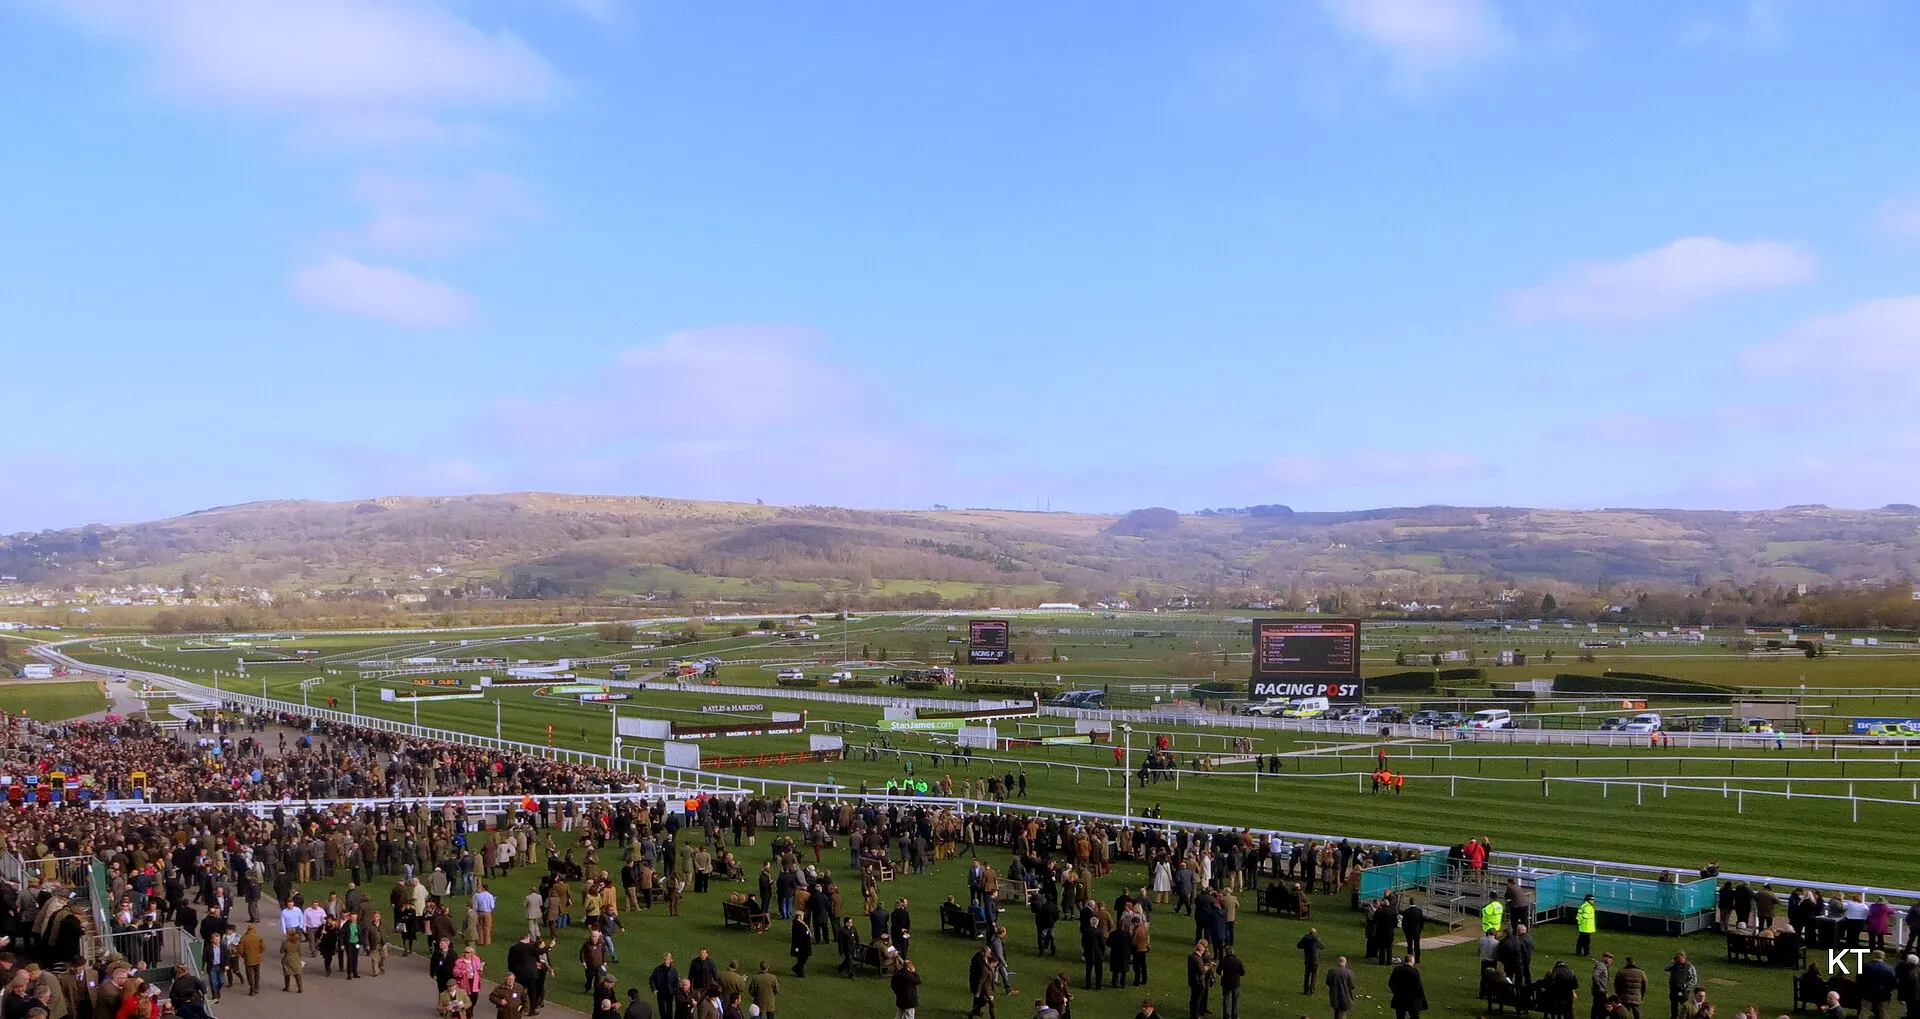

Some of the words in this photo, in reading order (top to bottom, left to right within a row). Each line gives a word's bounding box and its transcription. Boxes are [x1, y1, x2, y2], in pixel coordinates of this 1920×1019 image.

[1255, 683, 1314, 696] RACING
[1316, 684, 1358, 697] POST
[702, 705, 725, 713] BAYLIS
[731, 704, 764, 712] HARDING
[891, 721, 954, 730] StanJames.com
